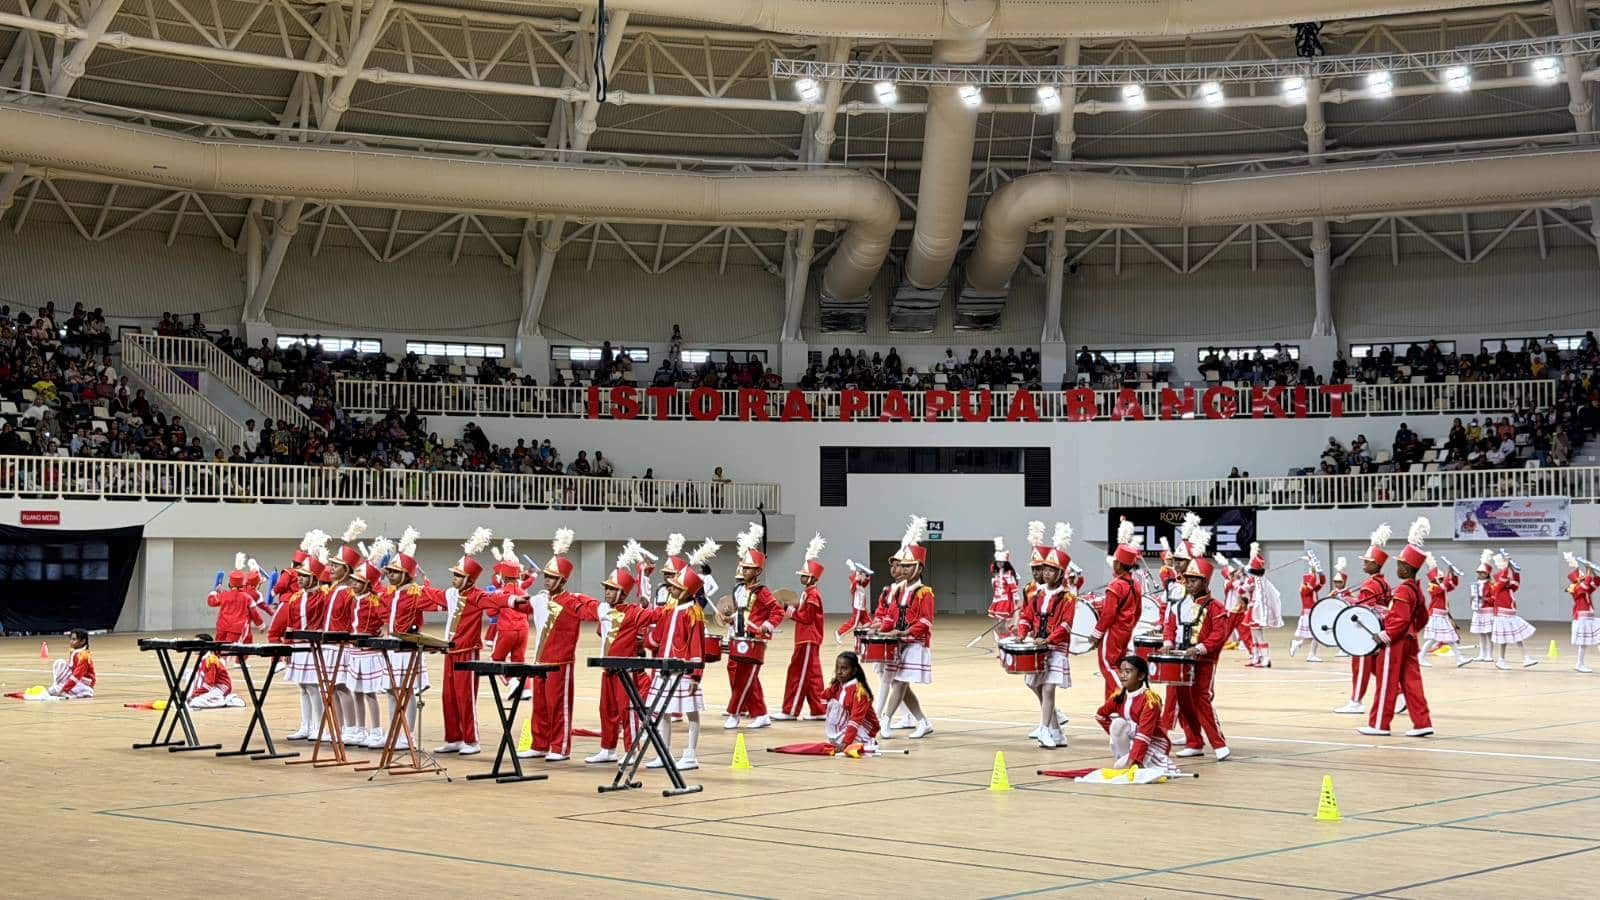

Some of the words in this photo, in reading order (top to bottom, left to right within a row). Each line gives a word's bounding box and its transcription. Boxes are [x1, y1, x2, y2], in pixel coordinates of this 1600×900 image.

[587, 385, 813, 421] ISTORA
[840, 387, 1040, 422] PAPUA
[1065, 384, 1353, 422] BANGKIT
[1159, 511, 1186, 521] ROYA
[929, 522, 941, 530] P4
[1131, 525, 1242, 551] LIE
